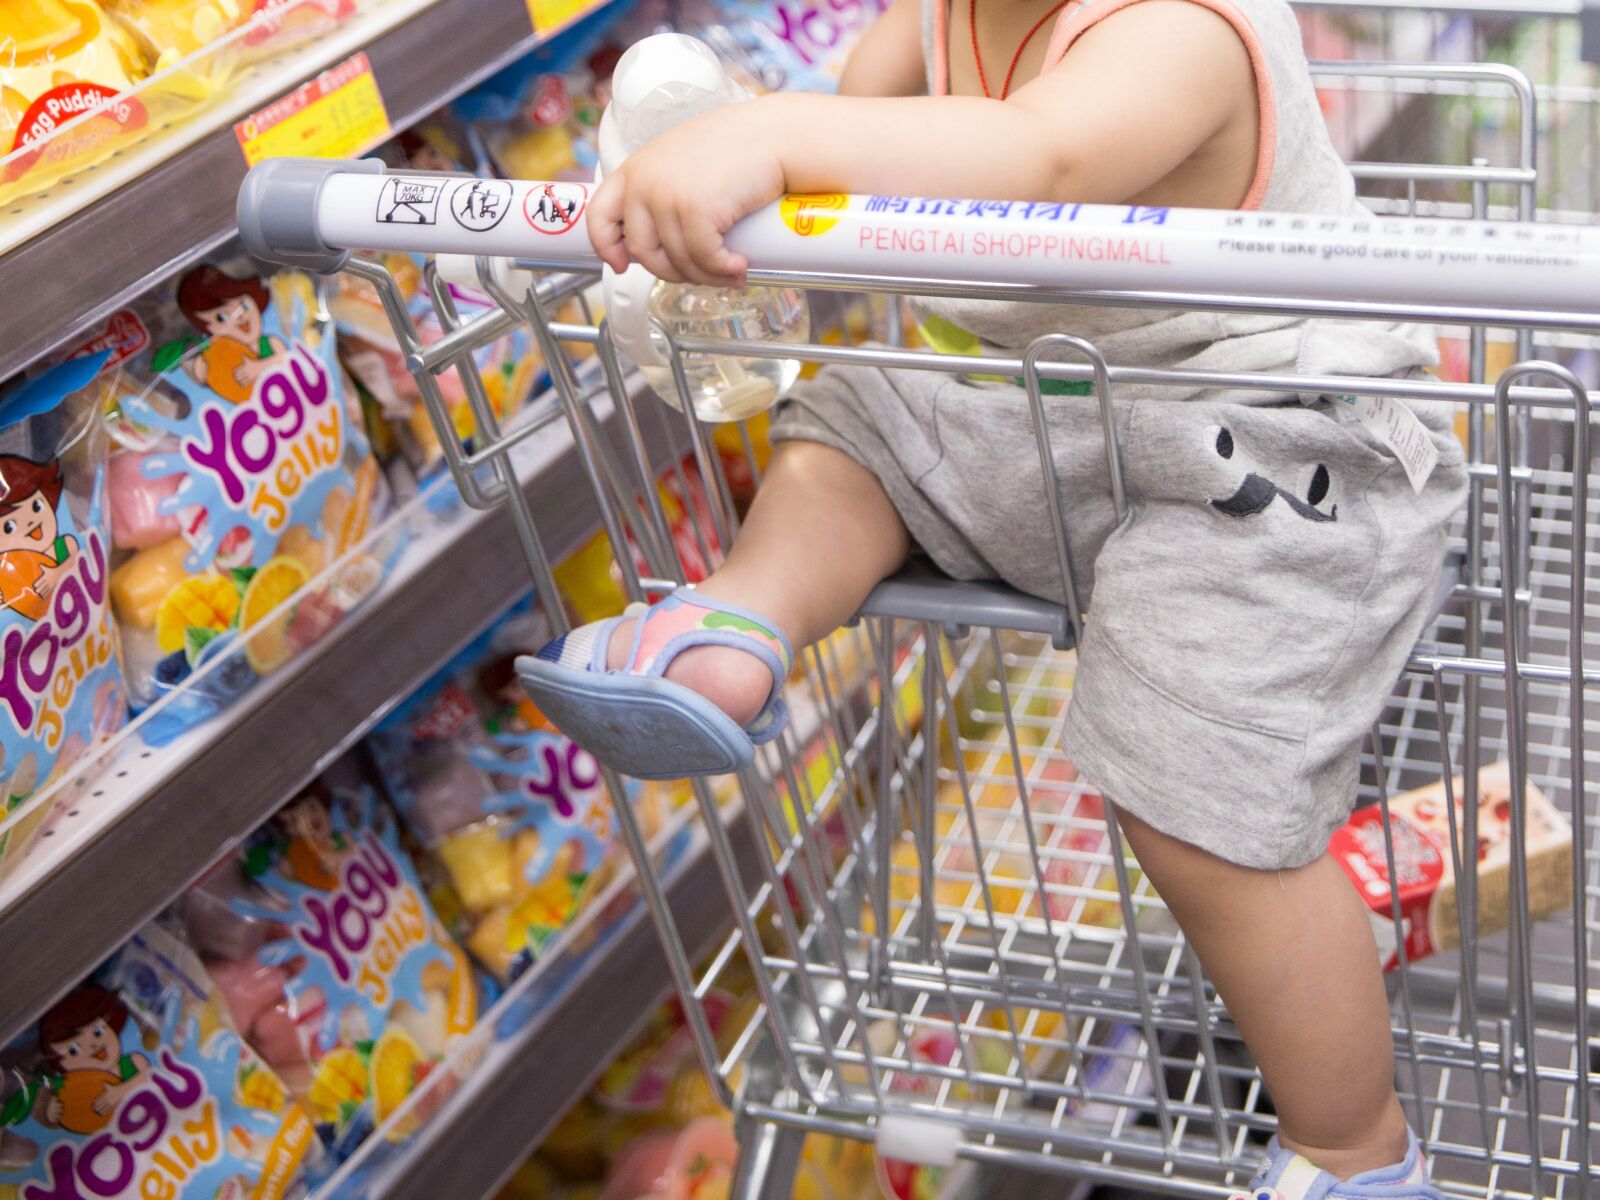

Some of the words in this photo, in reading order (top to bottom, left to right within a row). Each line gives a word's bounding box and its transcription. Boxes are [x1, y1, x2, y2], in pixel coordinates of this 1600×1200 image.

[402, 185, 427, 193] MAX
[860, 226, 965, 254] PENGTAI
[1321, 240, 1369, 261] good
[1372, 245, 1412, 260] care
[186, 343, 328, 503] Yogu
[252, 405, 340, 530] Jelly
[0, 532, 105, 731] Yogu
[301, 830, 398, 982] Yogu
[357, 886, 425, 1005] Jelly
[24, 1050, 203, 1200] Yogu
[140, 1099, 218, 1200] elly
